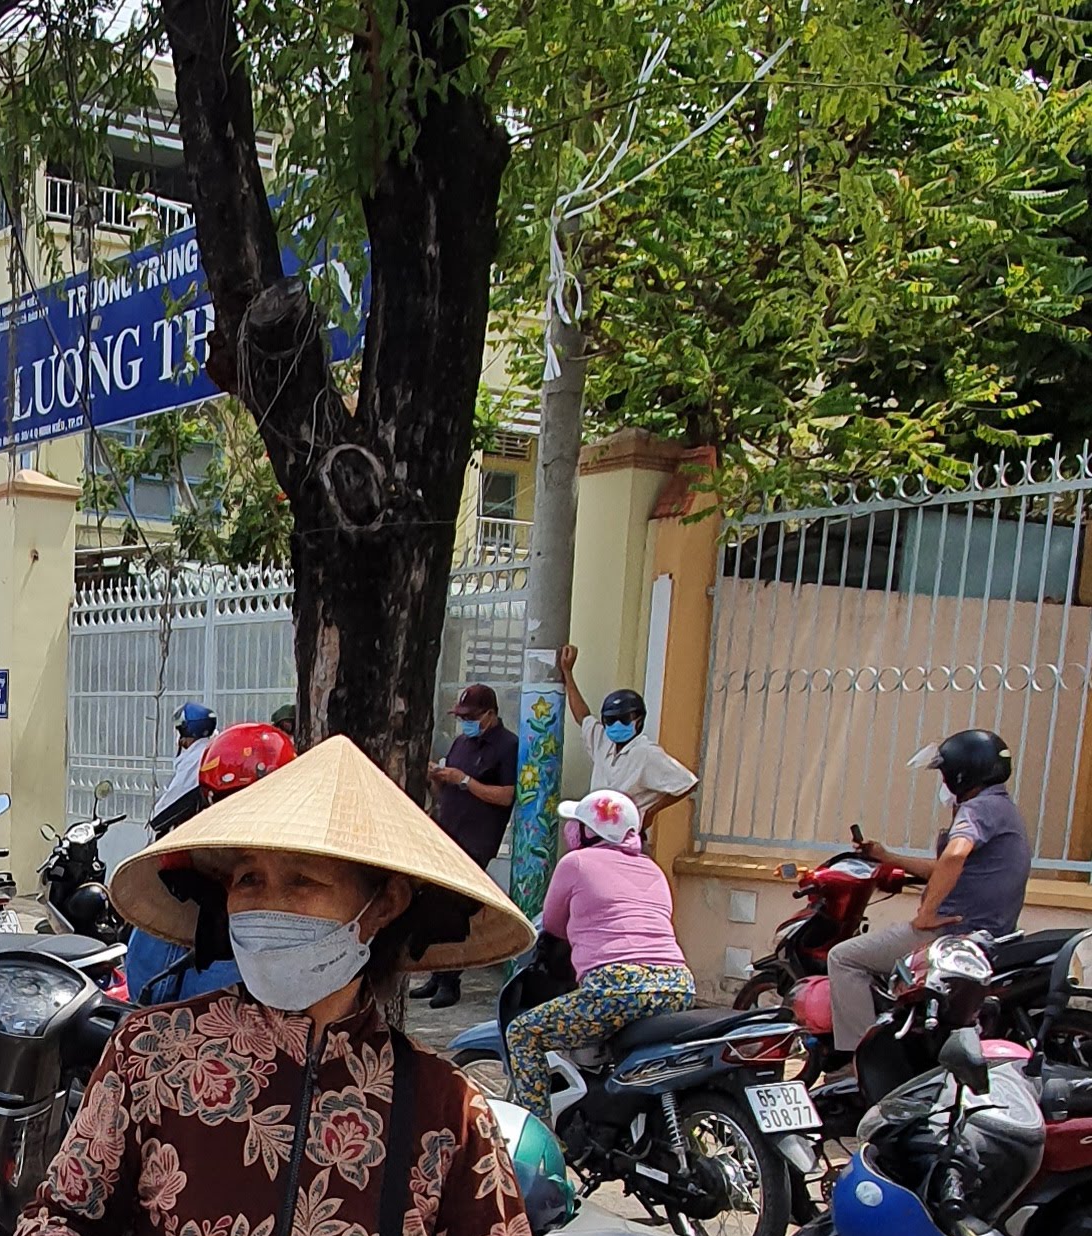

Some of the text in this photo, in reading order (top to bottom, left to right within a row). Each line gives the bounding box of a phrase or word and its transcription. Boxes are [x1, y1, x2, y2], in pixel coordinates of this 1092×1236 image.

[12, 325, 144, 422] LƯƠNG
[756, 1086, 802, 1108] 65-B2
[759, 1106, 813, 1129] 508.77
